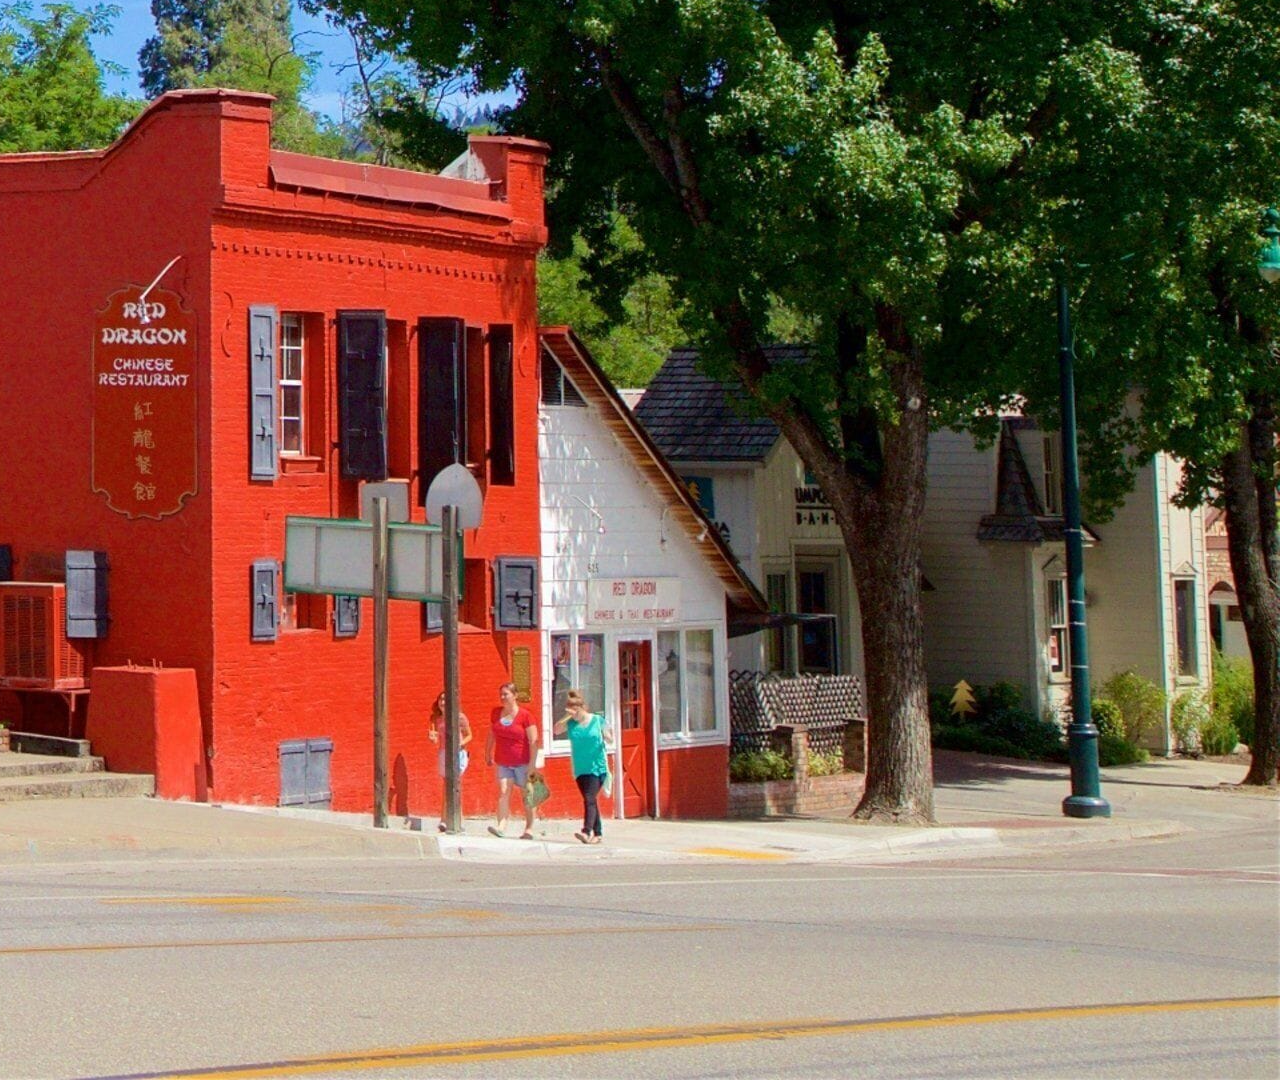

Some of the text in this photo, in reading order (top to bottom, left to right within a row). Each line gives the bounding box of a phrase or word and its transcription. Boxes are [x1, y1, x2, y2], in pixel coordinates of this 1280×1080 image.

[102, 327, 187, 345] DRAGON
[113, 357, 174, 372] CHINESE
[99, 373, 189, 387] RESTAURANT
[612, 582, 657, 596] RED DRAGON
